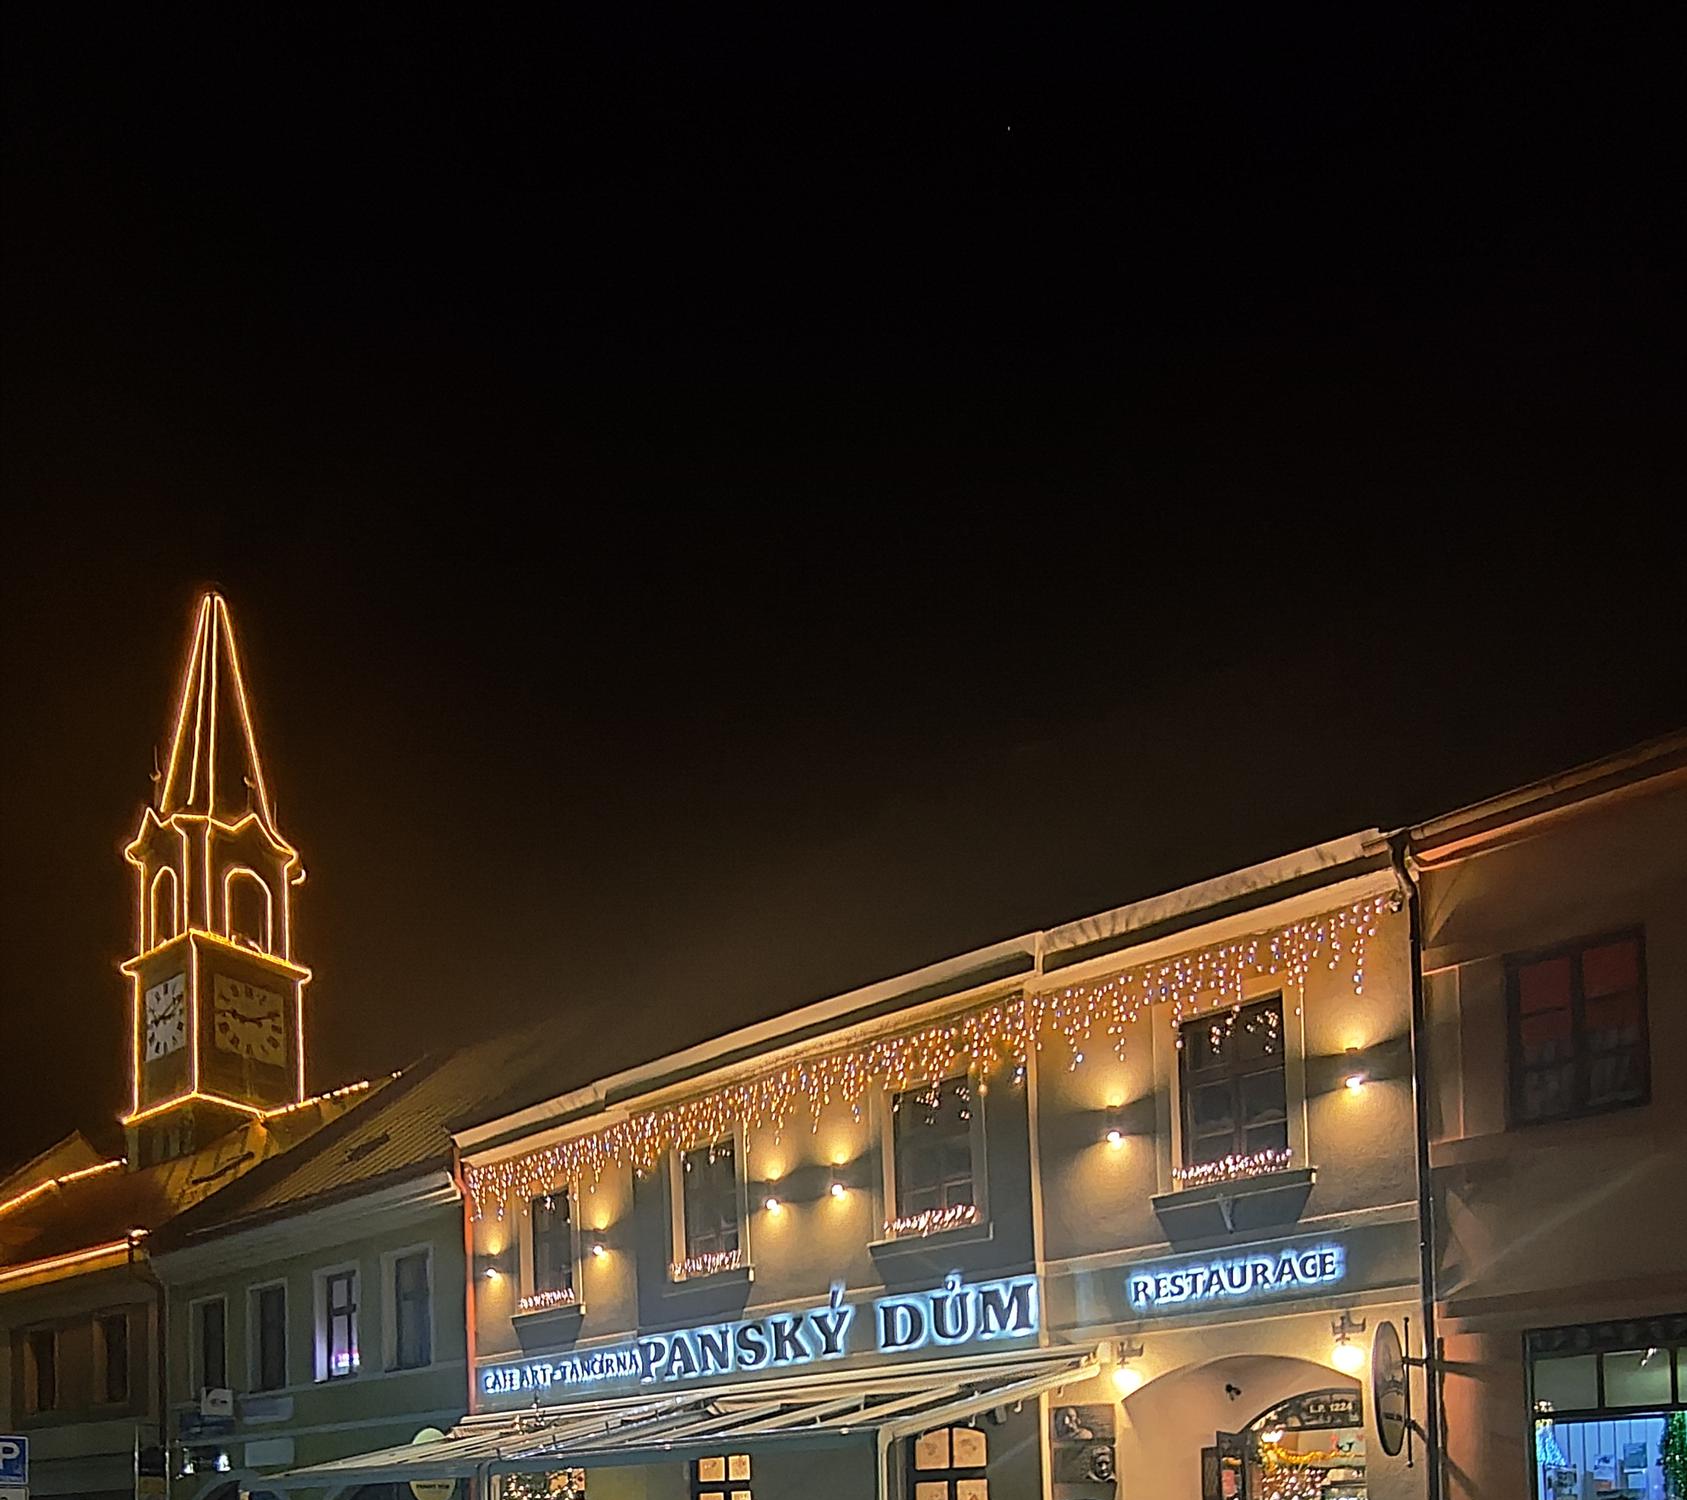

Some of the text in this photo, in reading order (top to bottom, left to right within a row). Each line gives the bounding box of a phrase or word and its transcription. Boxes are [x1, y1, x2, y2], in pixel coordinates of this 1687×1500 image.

[640, 1277, 1036, 1381] PANSKÝ DŮM
[0, 1442, 20, 1470] P
